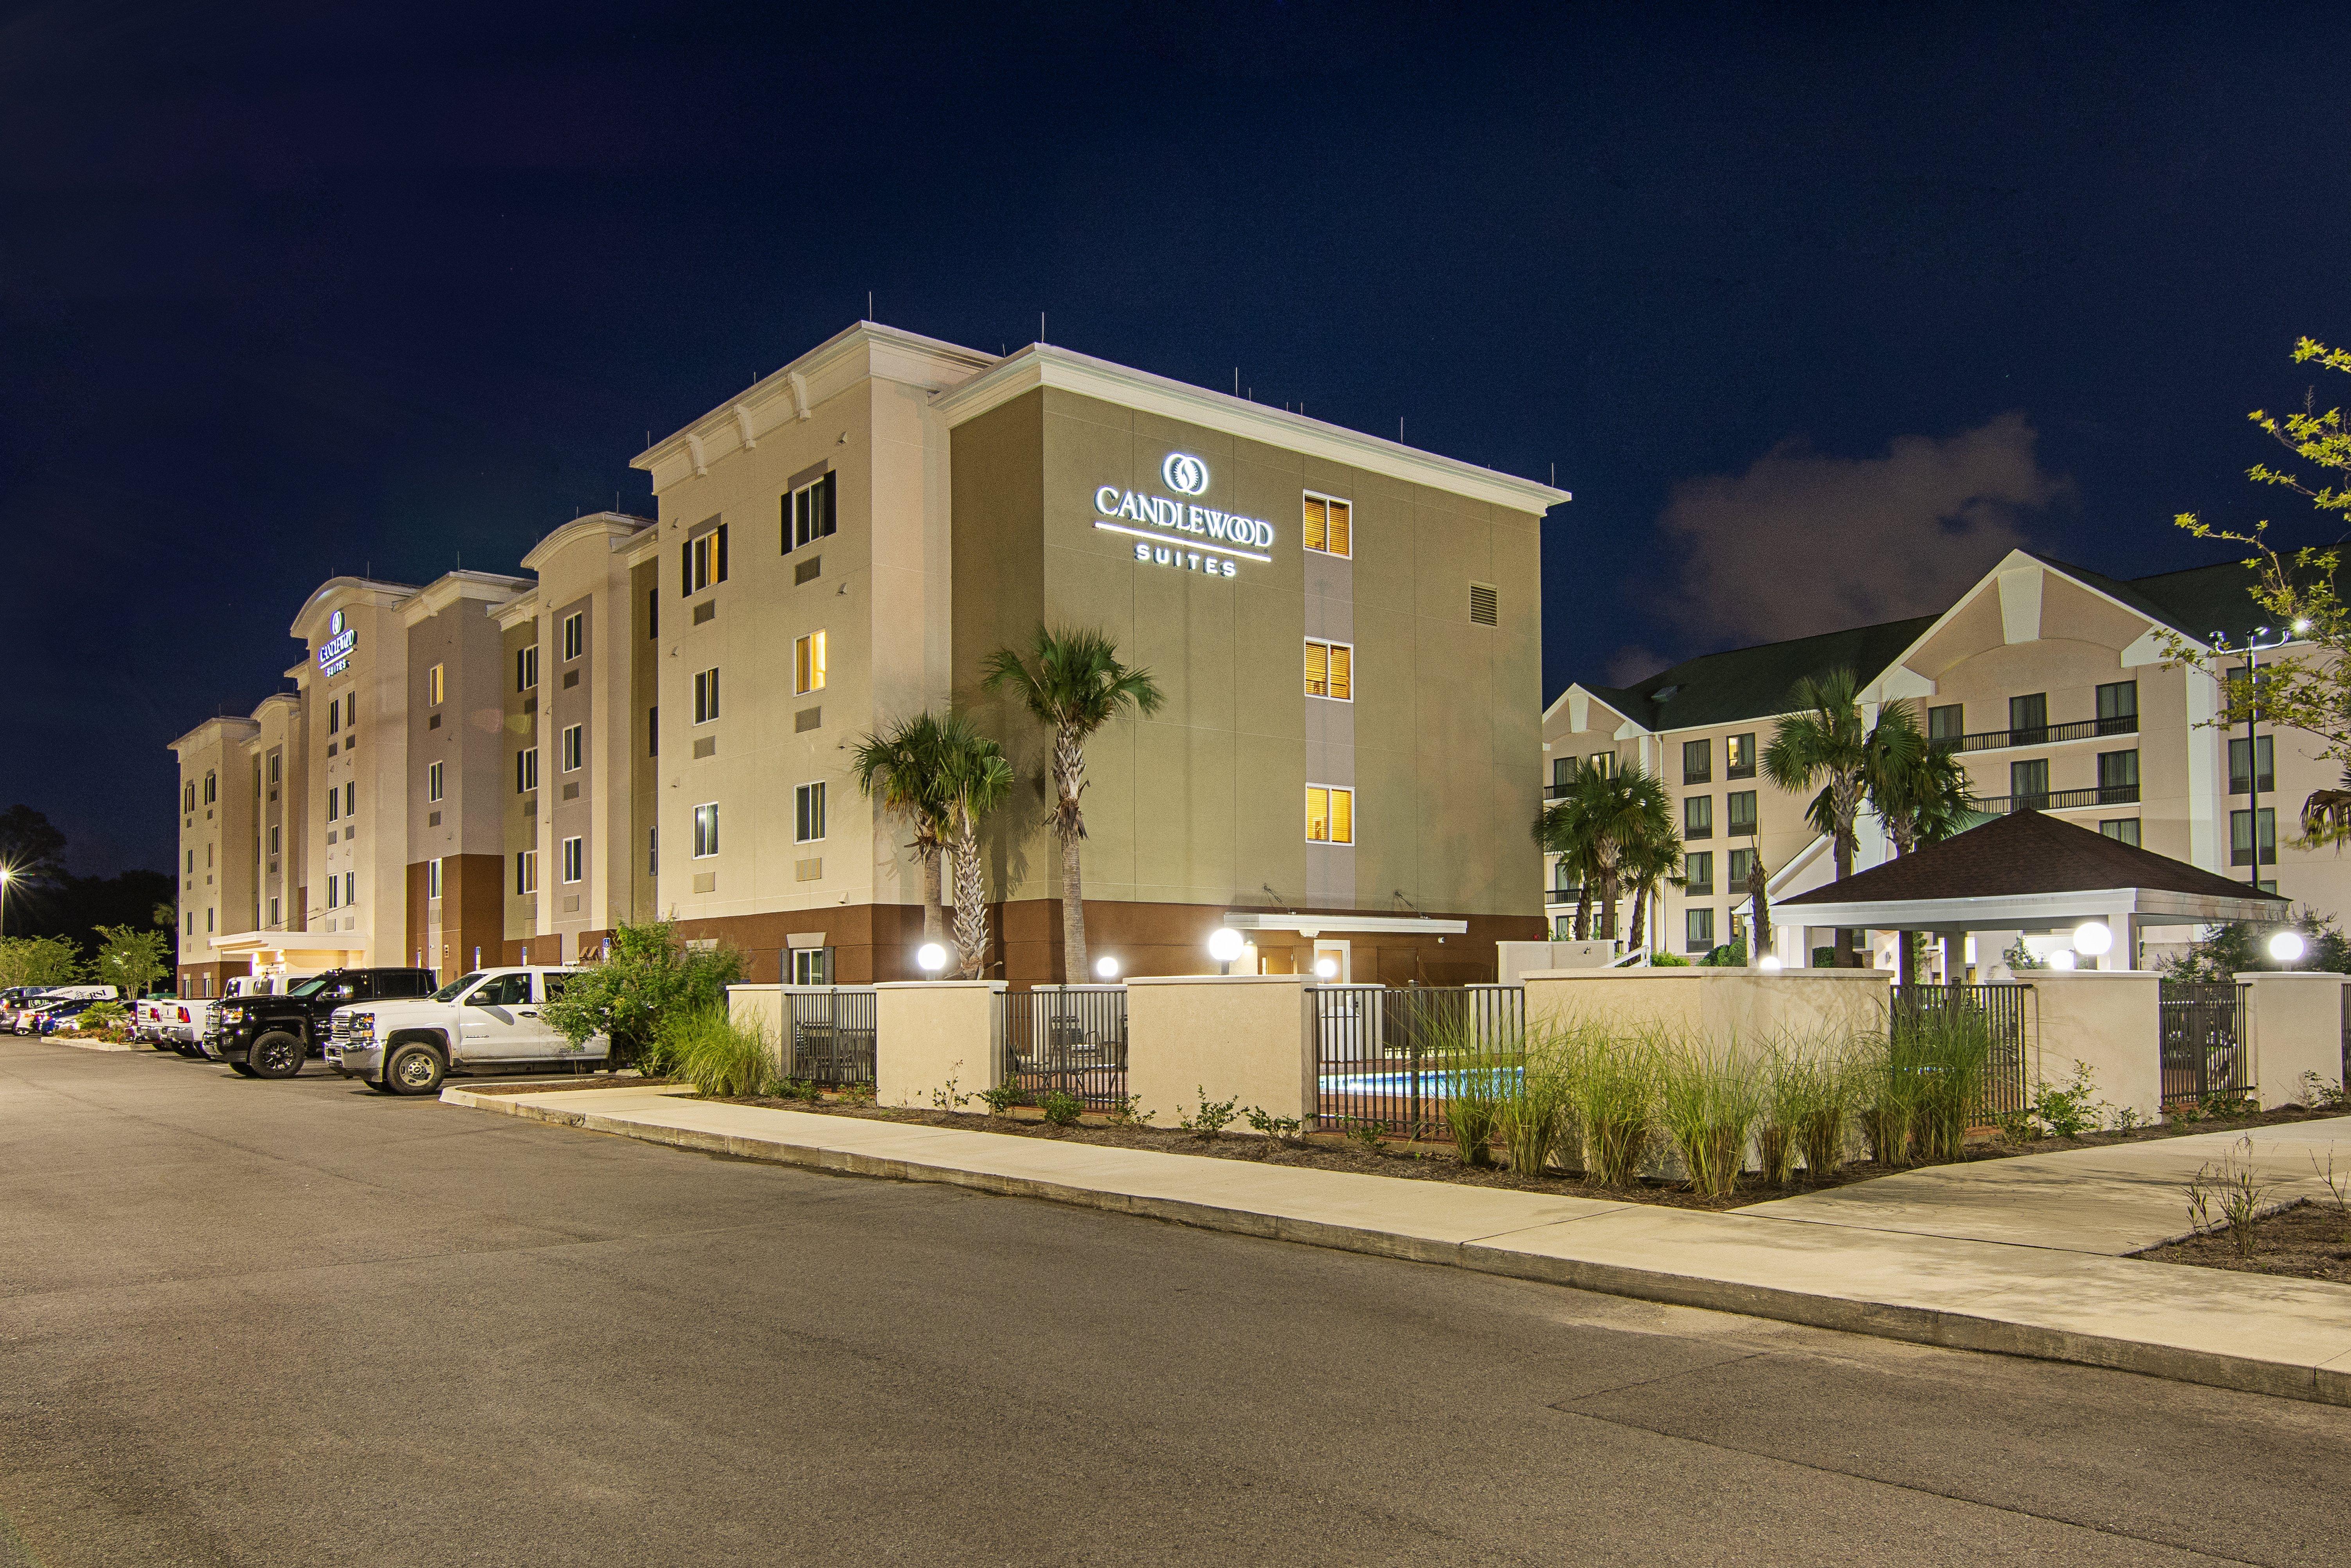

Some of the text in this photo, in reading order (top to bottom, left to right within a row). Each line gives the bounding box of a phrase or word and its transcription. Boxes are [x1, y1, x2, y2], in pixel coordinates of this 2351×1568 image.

[1095, 486, 1273, 547] CANDLEWOOD
[1135, 544, 1236, 577] SUITES
[326, 659, 346, 677] SUITES
[89, 990, 106, 999] RSI
